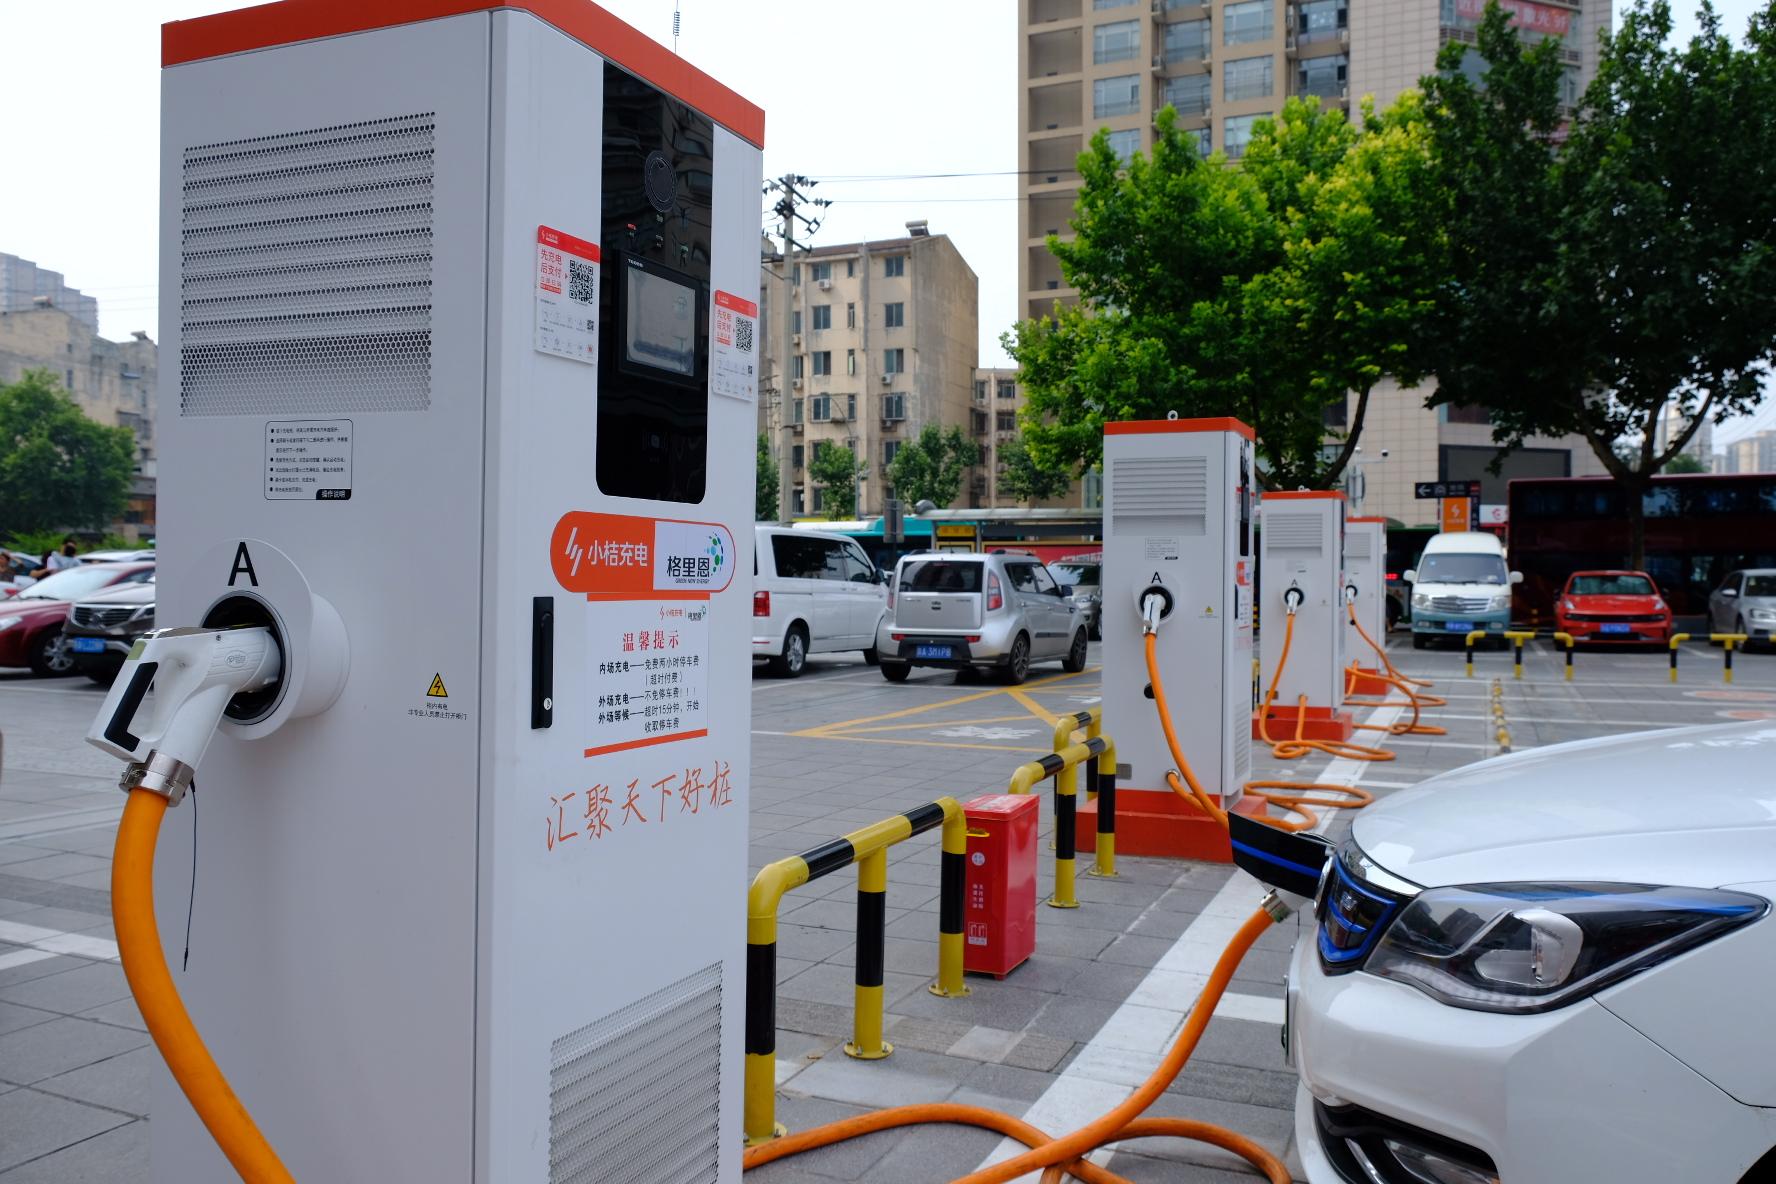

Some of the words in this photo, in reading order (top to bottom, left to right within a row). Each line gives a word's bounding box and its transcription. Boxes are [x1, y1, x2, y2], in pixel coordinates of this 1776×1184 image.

[541, 248, 562, 265] 先充电
[541, 262, 561, 278] 后支付
[228, 542, 258, 586] A
[588, 540, 648, 567] 小桔充电
[667, 556, 710, 577] 格里恩
[1151, 571, 1162, 584] A
[623, 629, 679, 652] 温馨提示
[645, 717, 680, 733] 收取停车费
[547, 760, 734, 852] 汇聚天下好桩
